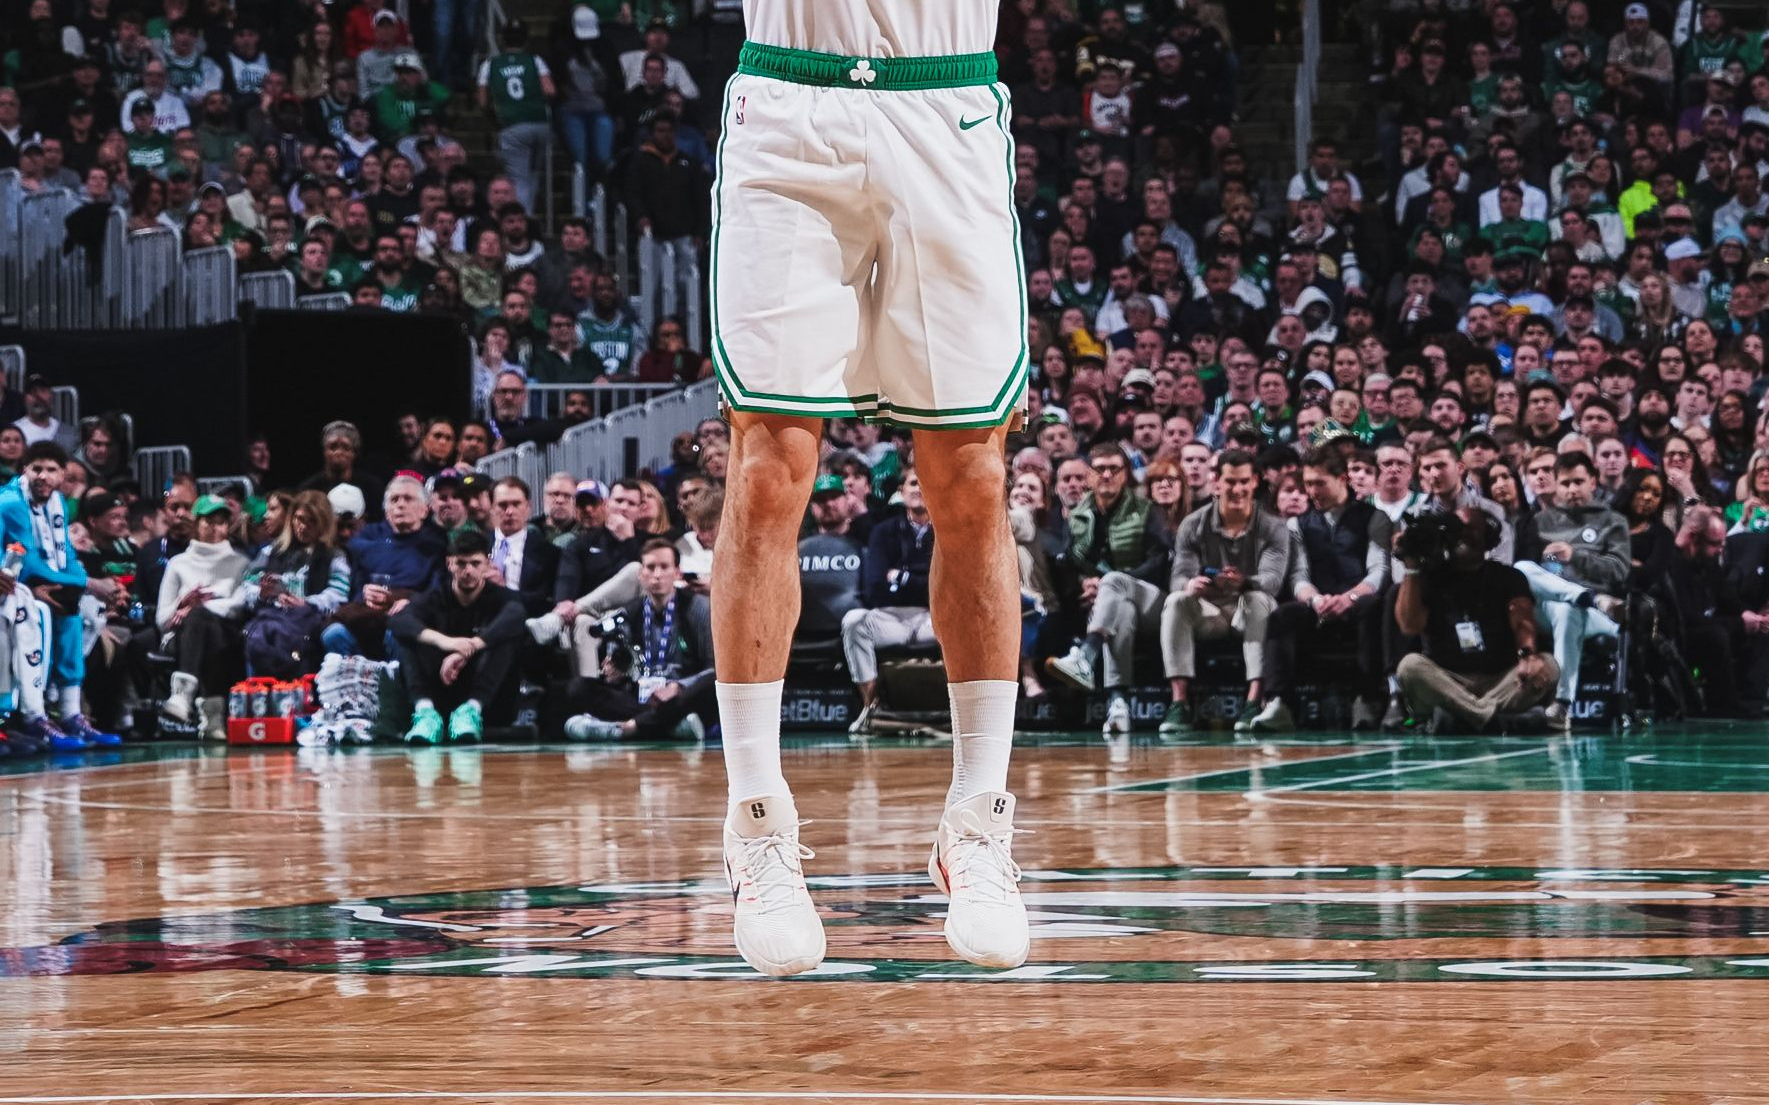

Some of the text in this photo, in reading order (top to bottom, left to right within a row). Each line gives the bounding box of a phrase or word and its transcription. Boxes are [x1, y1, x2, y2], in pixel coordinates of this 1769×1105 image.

[506, 77, 525, 101] 0
[799, 554, 861, 572] IMCO
[248, 722, 266, 741] G
